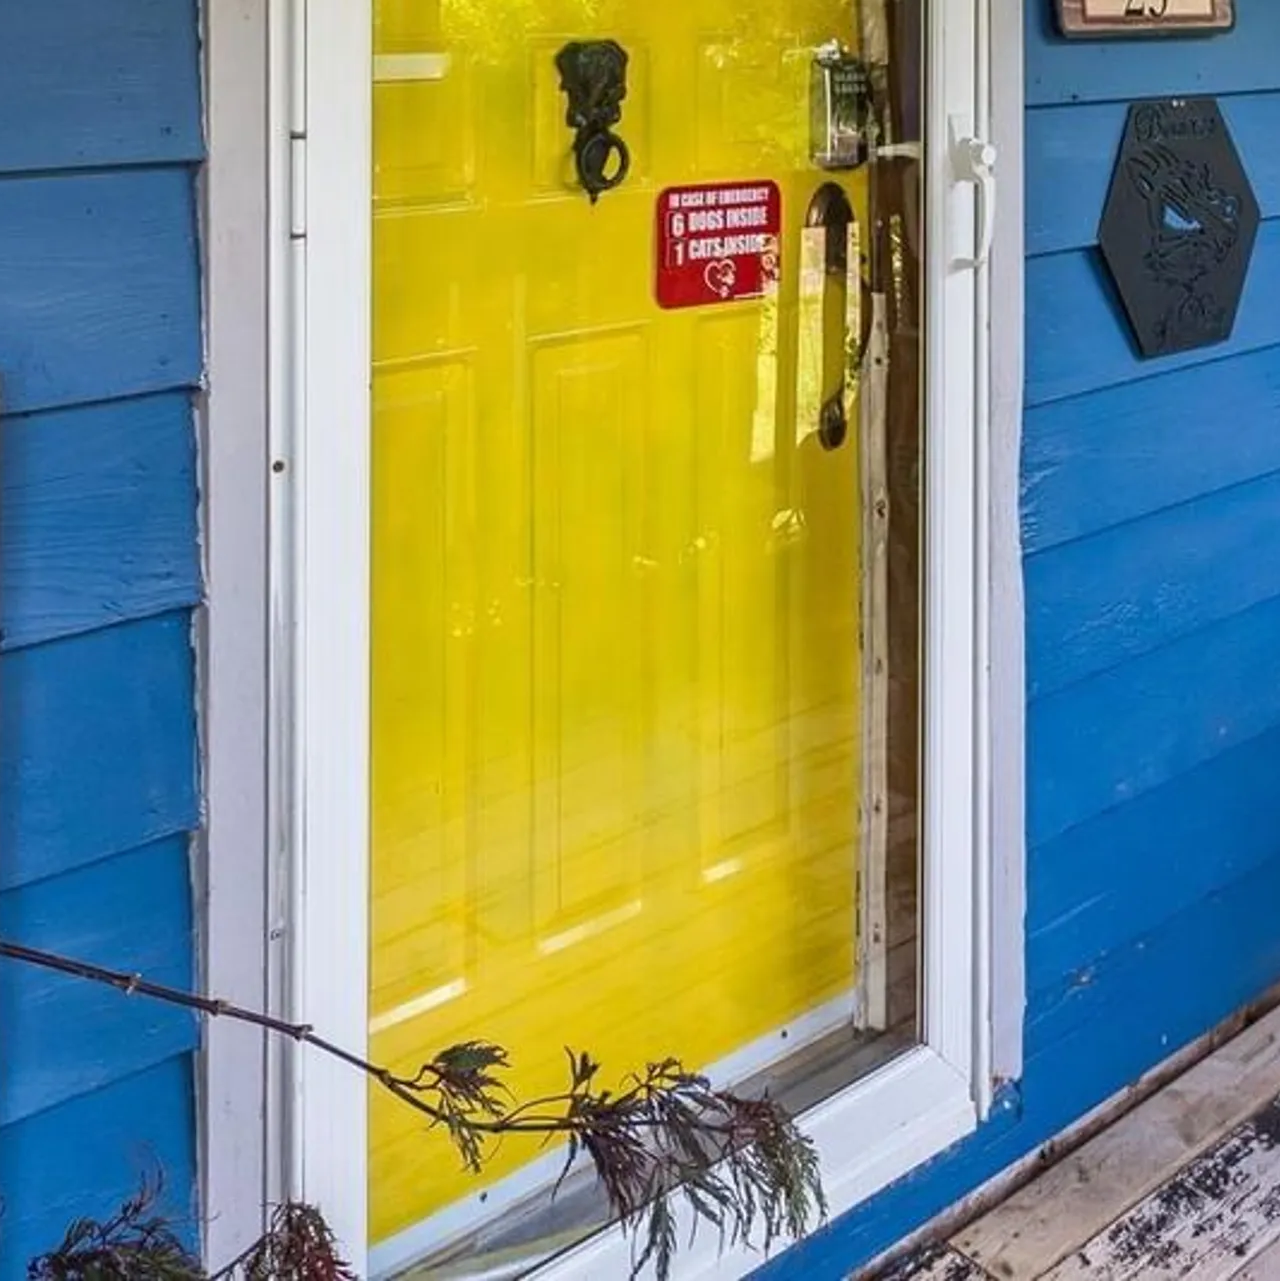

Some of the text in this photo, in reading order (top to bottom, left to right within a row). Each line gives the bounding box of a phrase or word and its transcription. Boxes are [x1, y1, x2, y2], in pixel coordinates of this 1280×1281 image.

[672, 207, 767, 237] 6 DOGS INSIDE
